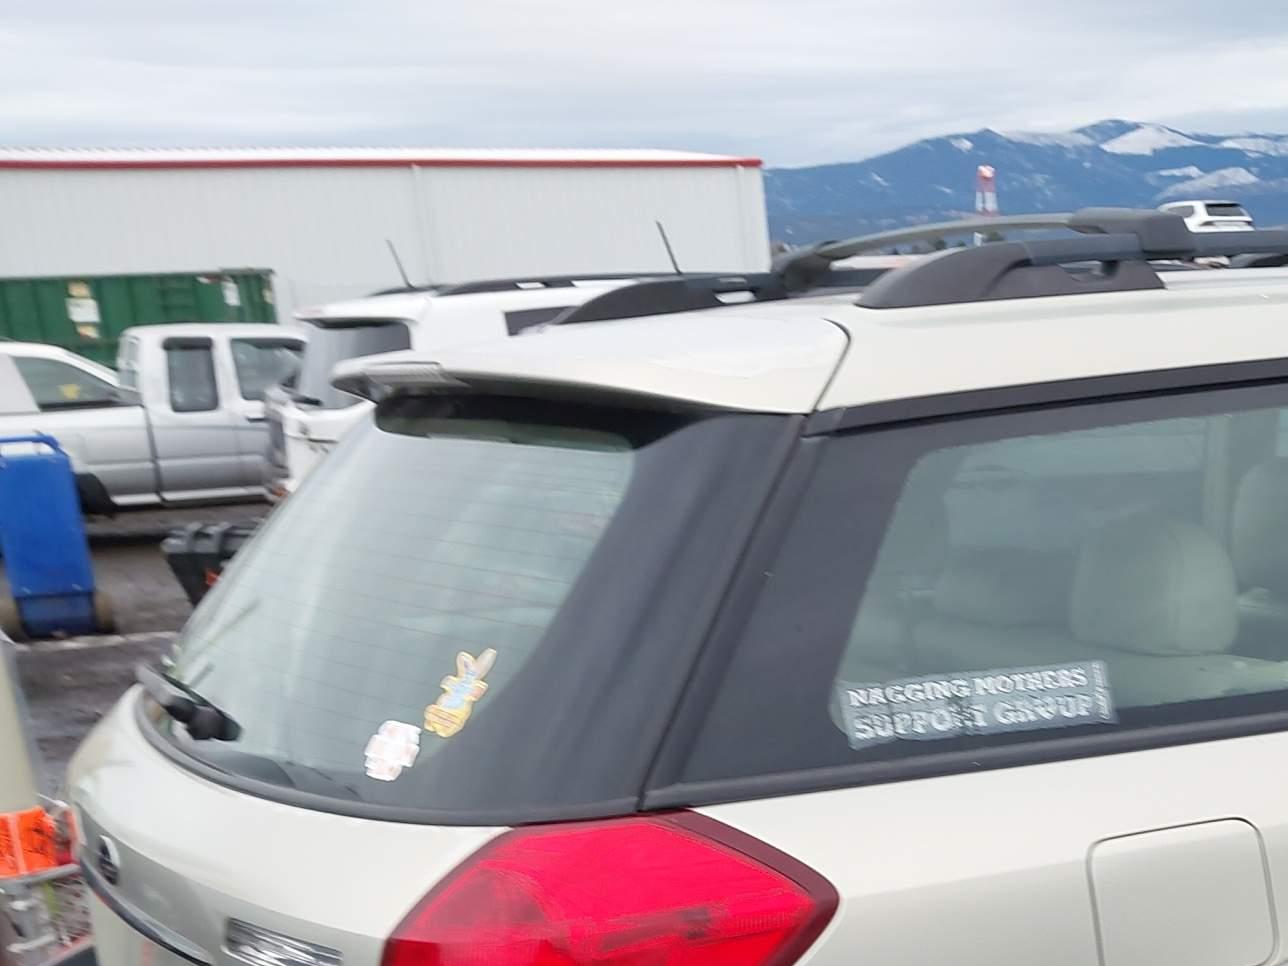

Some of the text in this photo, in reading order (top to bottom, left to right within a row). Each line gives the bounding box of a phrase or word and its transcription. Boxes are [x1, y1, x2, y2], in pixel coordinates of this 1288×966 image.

[847, 679, 971, 707] NAGGING
[972, 667, 1089, 696] MOTHERS
[853, 693, 1093, 741] SUPPORT GROUP
